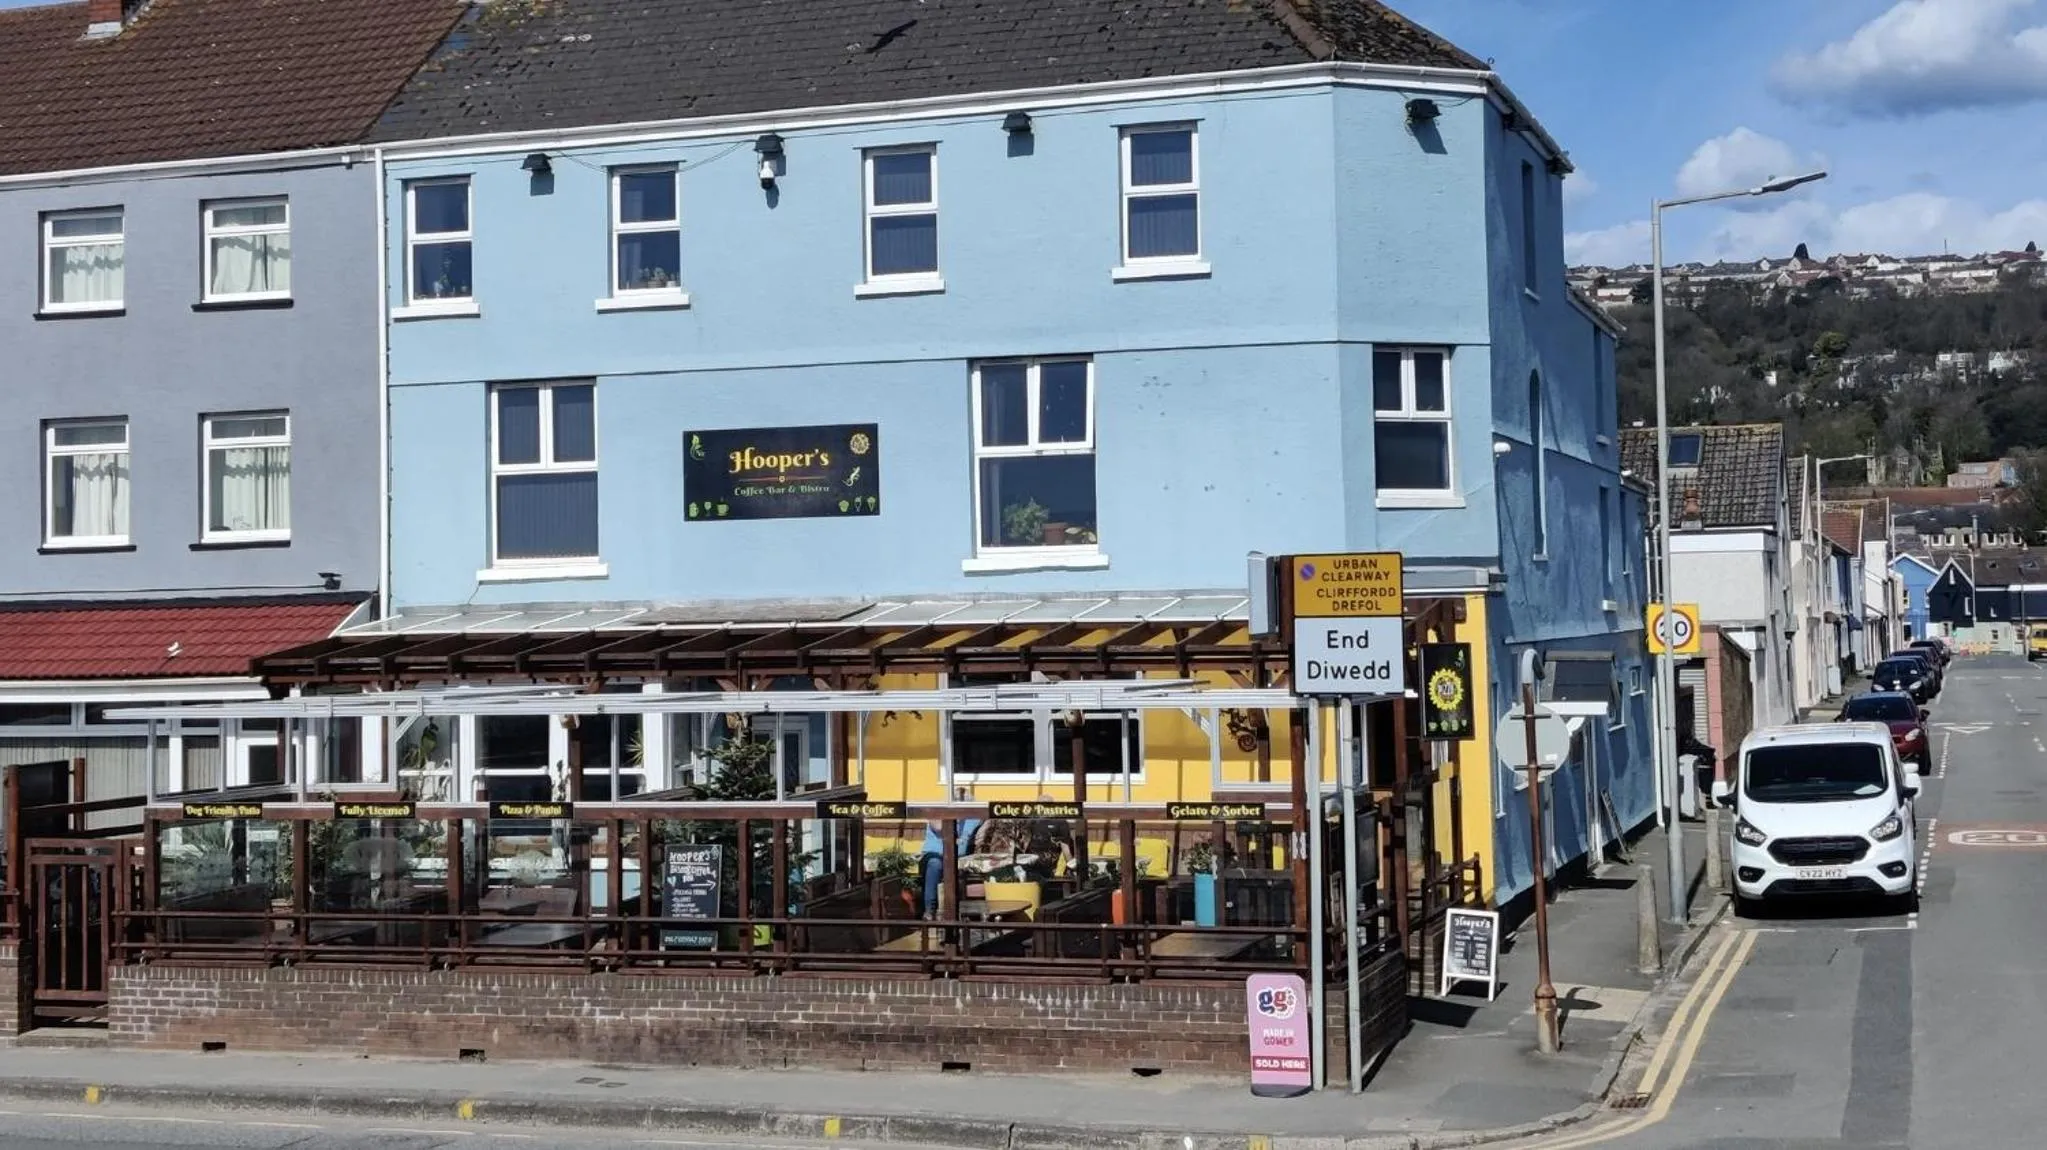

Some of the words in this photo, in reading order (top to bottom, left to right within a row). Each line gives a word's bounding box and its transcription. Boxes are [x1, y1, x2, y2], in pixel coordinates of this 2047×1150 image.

[728, 447, 830, 473] Hooper's
[734, 486, 764, 497] Coffee
[766, 486, 785, 495] Bar
[788, 485, 796, 493] &
[800, 485, 830, 494] Bistro
[1333, 559, 1378, 570] URBAN
[1321, 571, 1390, 582] CLEARWAY
[1316, 587, 1396, 598] CLIRFFORDD
[1332, 601, 1382, 611] DREFOL
[1327, 630, 1369, 649] End
[1307, 660, 1391, 680] Diwedd
[339, 805, 365, 816] Fully
[499, 805, 524, 815] Pizza
[524, 805, 533, 815] &
[829, 804, 849, 815] Tea
[850, 804, 860, 815] &
[862, 804, 895, 816] Coffee
[993, 804, 1019, 817] Cake
[1022, 804, 1032, 815] &
[1034, 804, 1079, 816] Pastries
[1171, 805, 1208, 817] Gelato
[1210, 805, 1220, 815] &
[1223, 804, 1261, 816] Sorbet
[1255, 1059, 1280, 1068] SOLD
[1281, 1060, 1306, 1069] HERE
